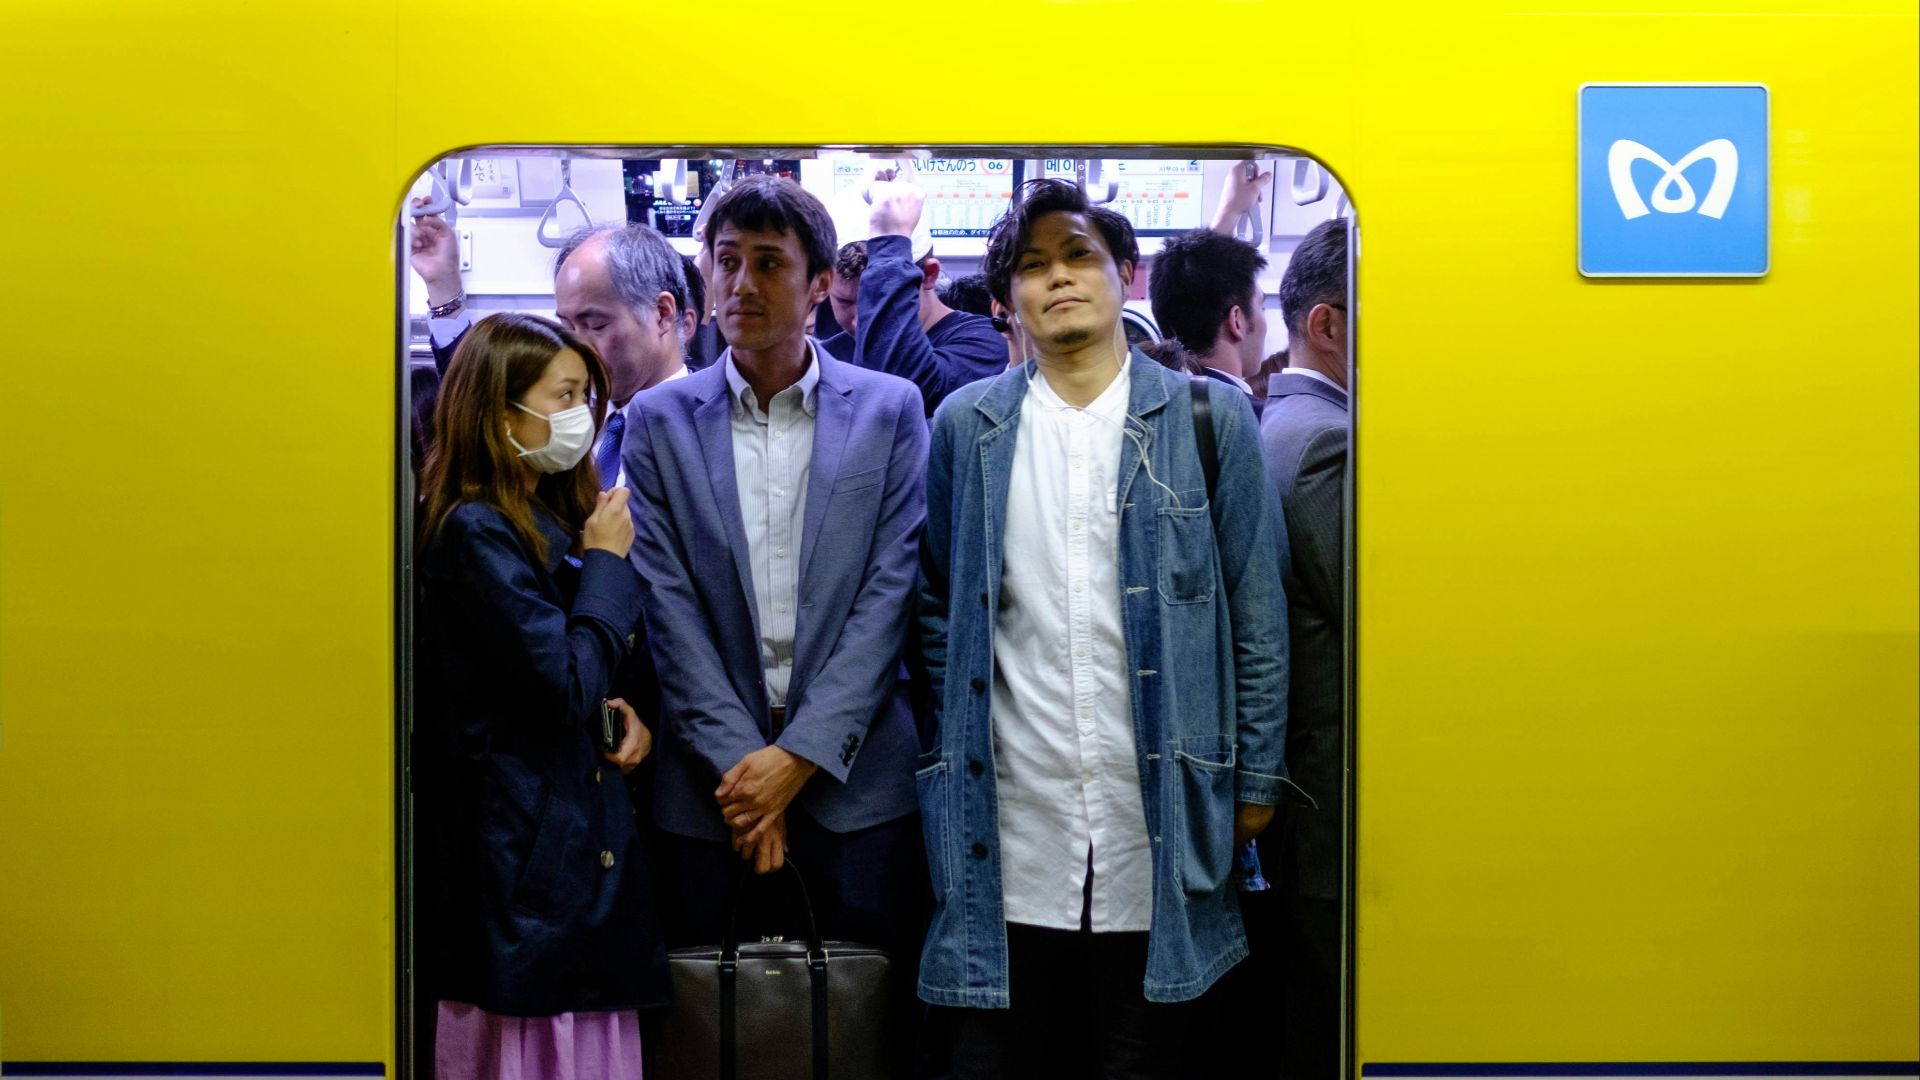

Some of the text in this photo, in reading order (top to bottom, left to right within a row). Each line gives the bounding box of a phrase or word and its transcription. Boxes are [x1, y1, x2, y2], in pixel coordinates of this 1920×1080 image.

[911, 159, 1004, 172] いけさんのう 06
